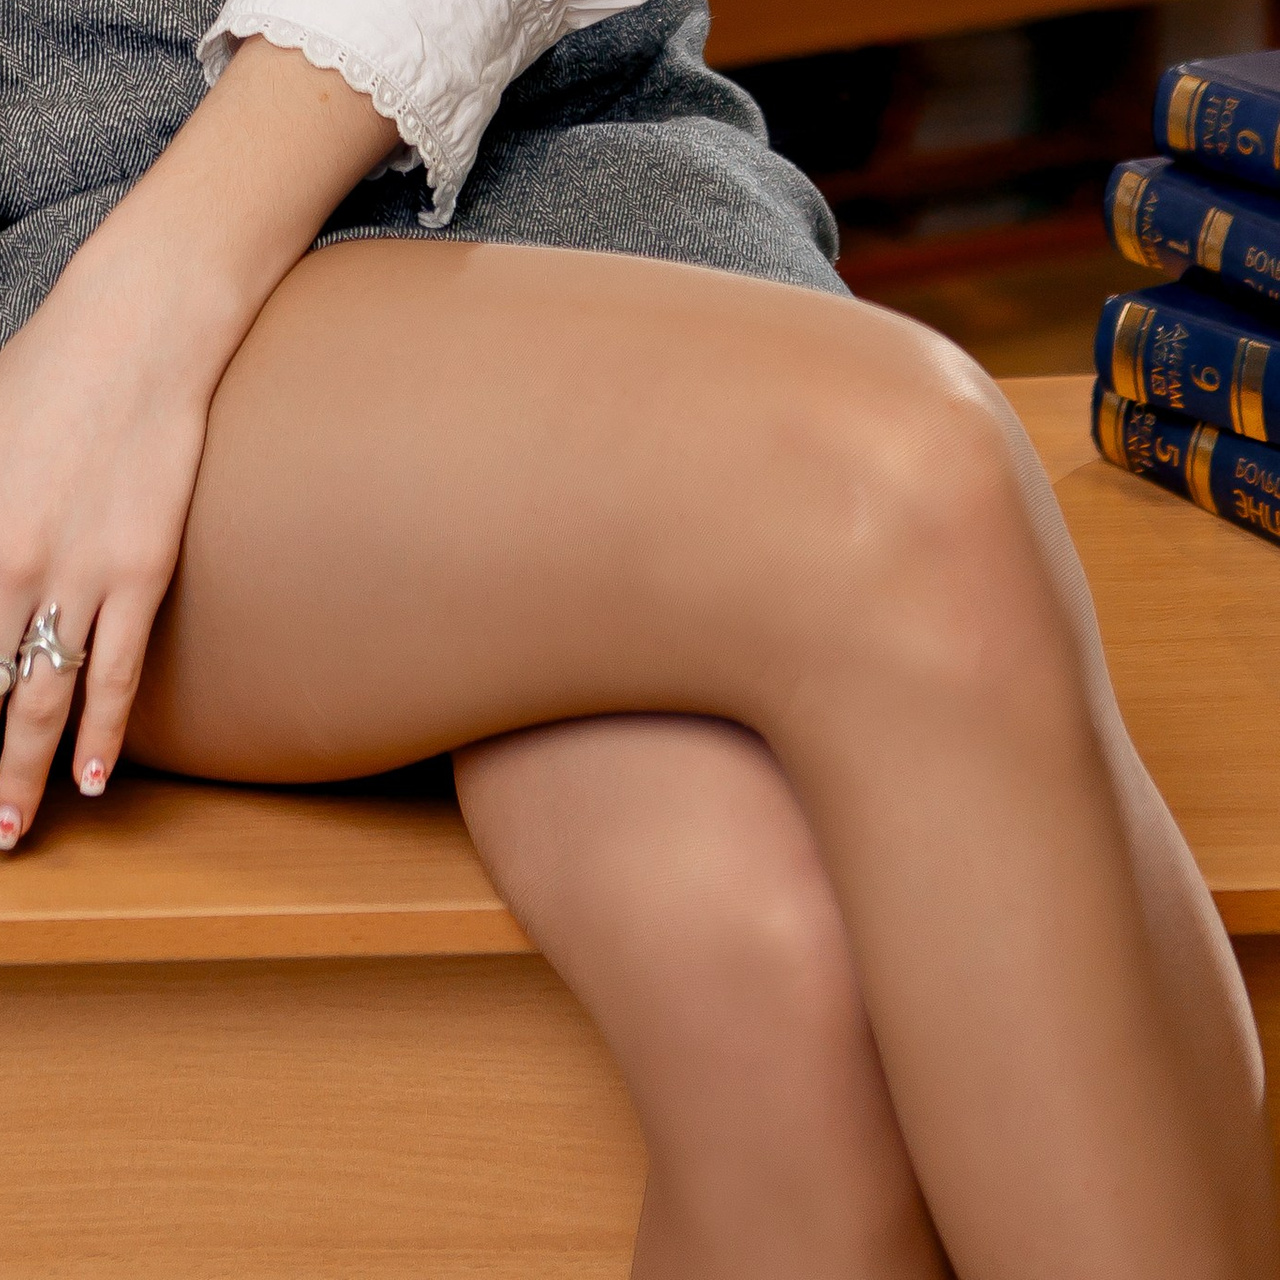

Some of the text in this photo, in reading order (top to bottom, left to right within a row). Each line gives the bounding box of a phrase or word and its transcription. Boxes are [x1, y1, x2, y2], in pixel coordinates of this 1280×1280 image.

[1236, 129, 1266, 156] 6
[1190, 363, 1221, 392] 9
[1155, 436, 1181, 467] 5
